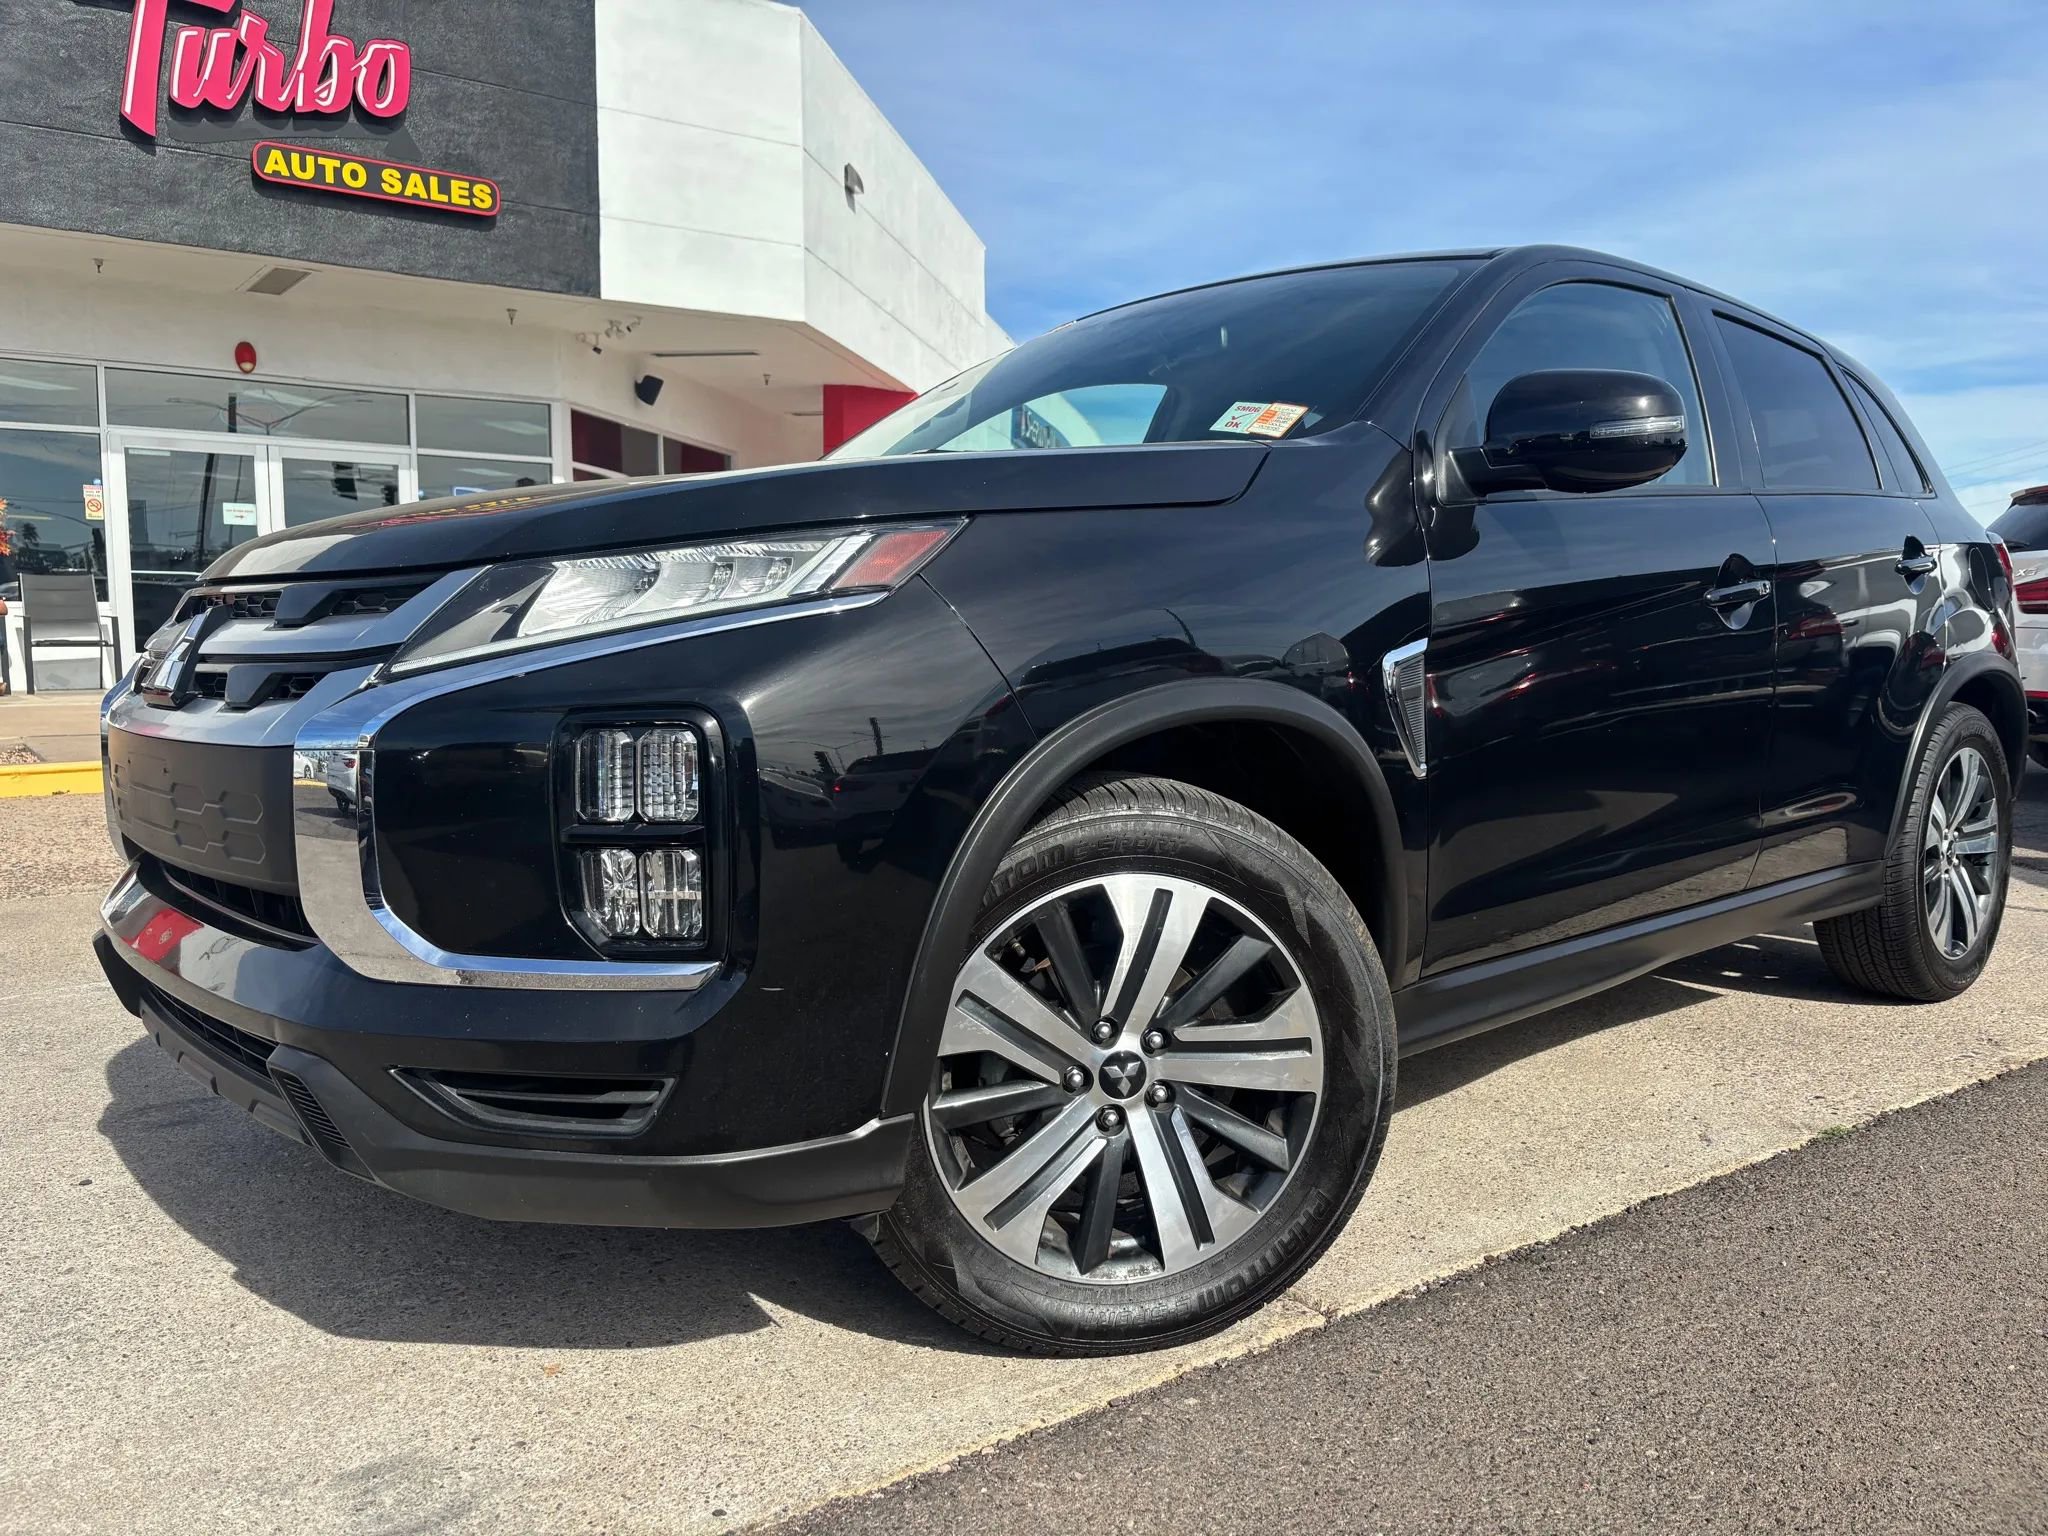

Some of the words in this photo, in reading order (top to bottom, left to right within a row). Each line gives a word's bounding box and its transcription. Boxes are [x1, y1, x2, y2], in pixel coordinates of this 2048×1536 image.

[120, 0, 411, 136] Turbo
[263, 150, 367, 189] AUTO
[381, 169, 494, 210] SALES
[1235, 405, 1262, 413] SMOG
[1197, 1186, 1330, 1313] PHANTOM
